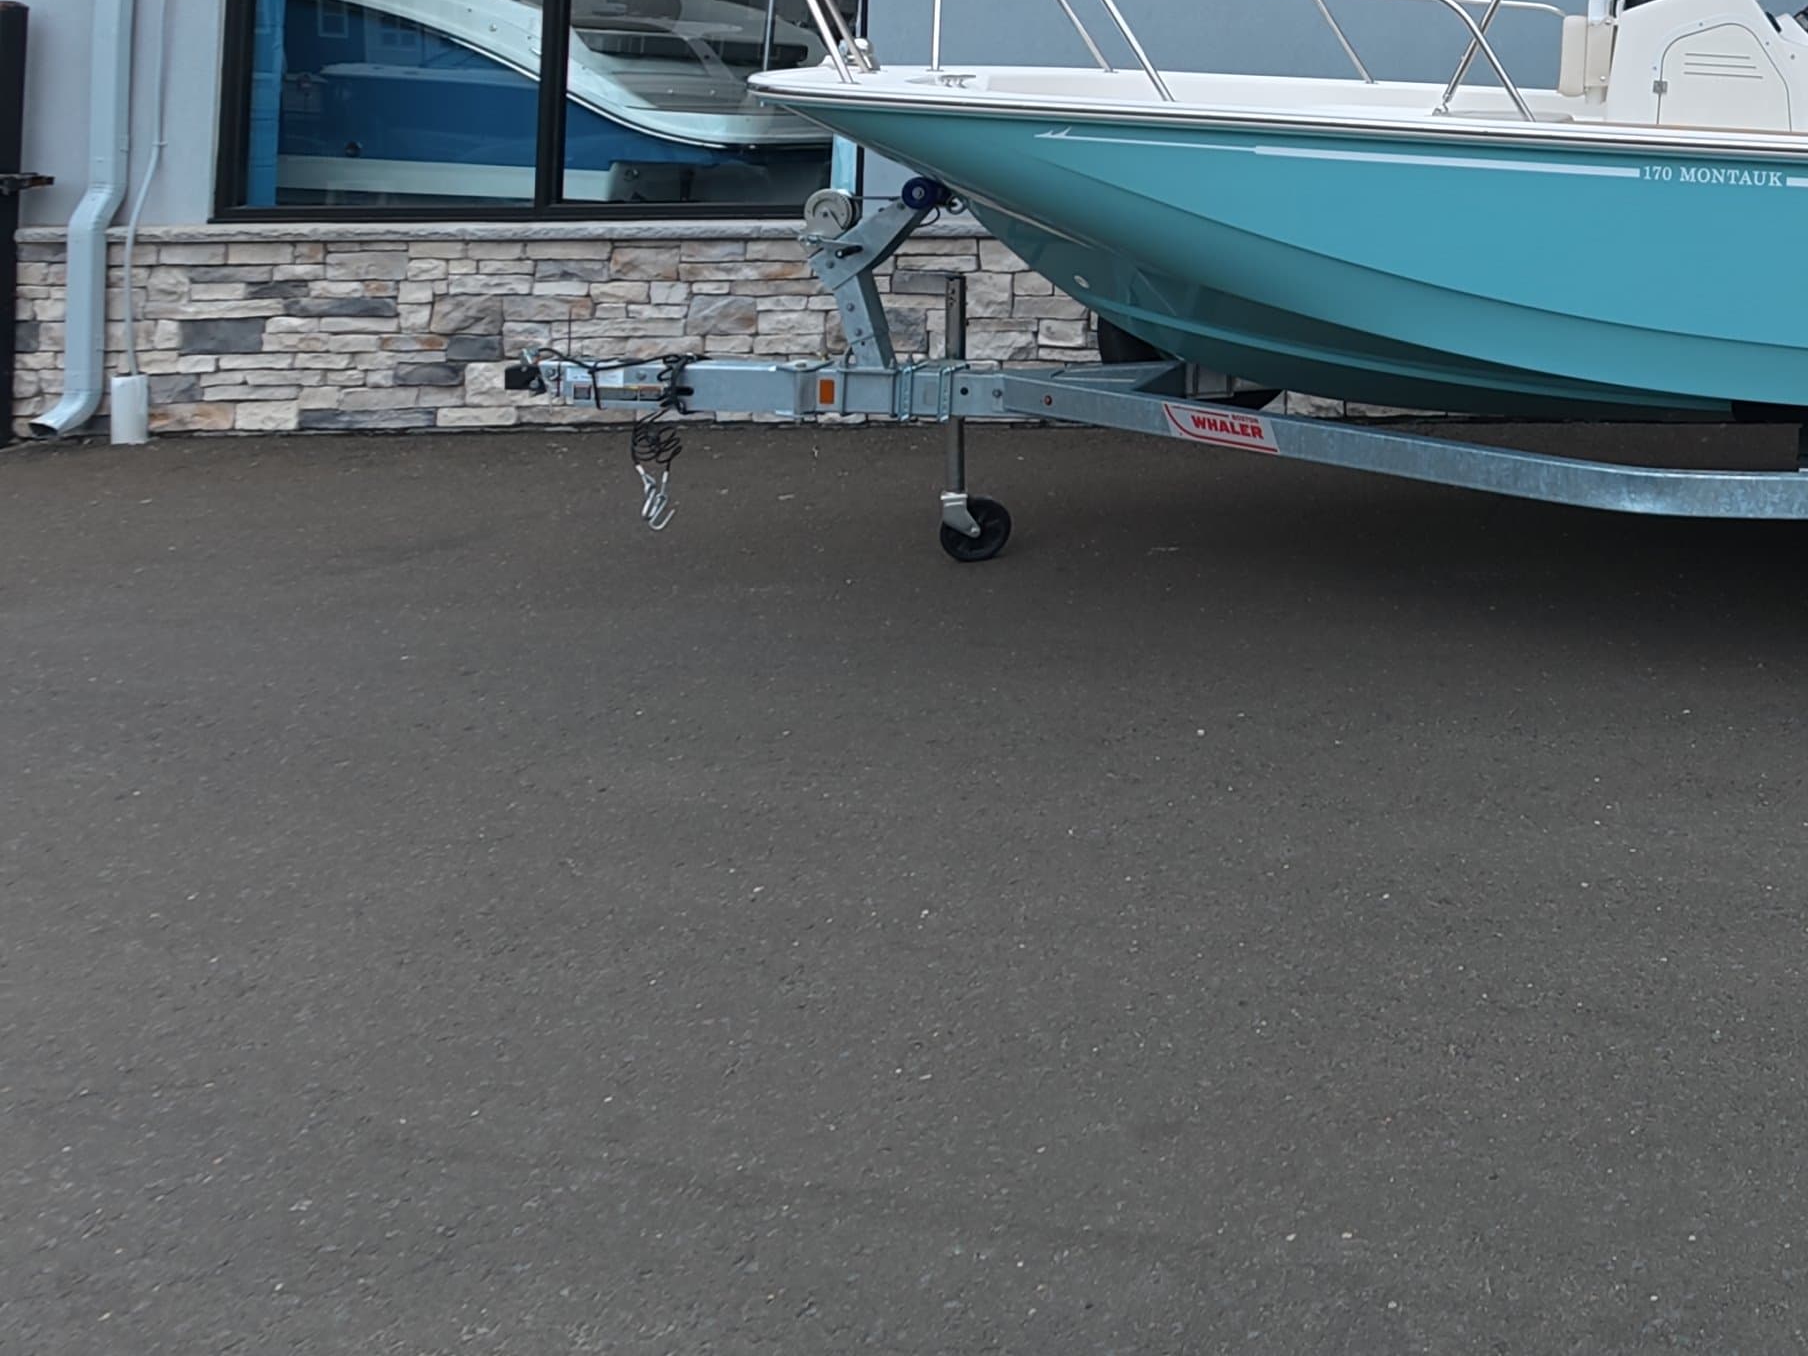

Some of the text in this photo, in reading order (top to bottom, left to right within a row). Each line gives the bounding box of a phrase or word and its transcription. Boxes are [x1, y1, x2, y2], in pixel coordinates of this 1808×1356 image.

[1643, 165, 1783, 187] 170 MONTAUK
[1190, 414, 1265, 441] WHALER
